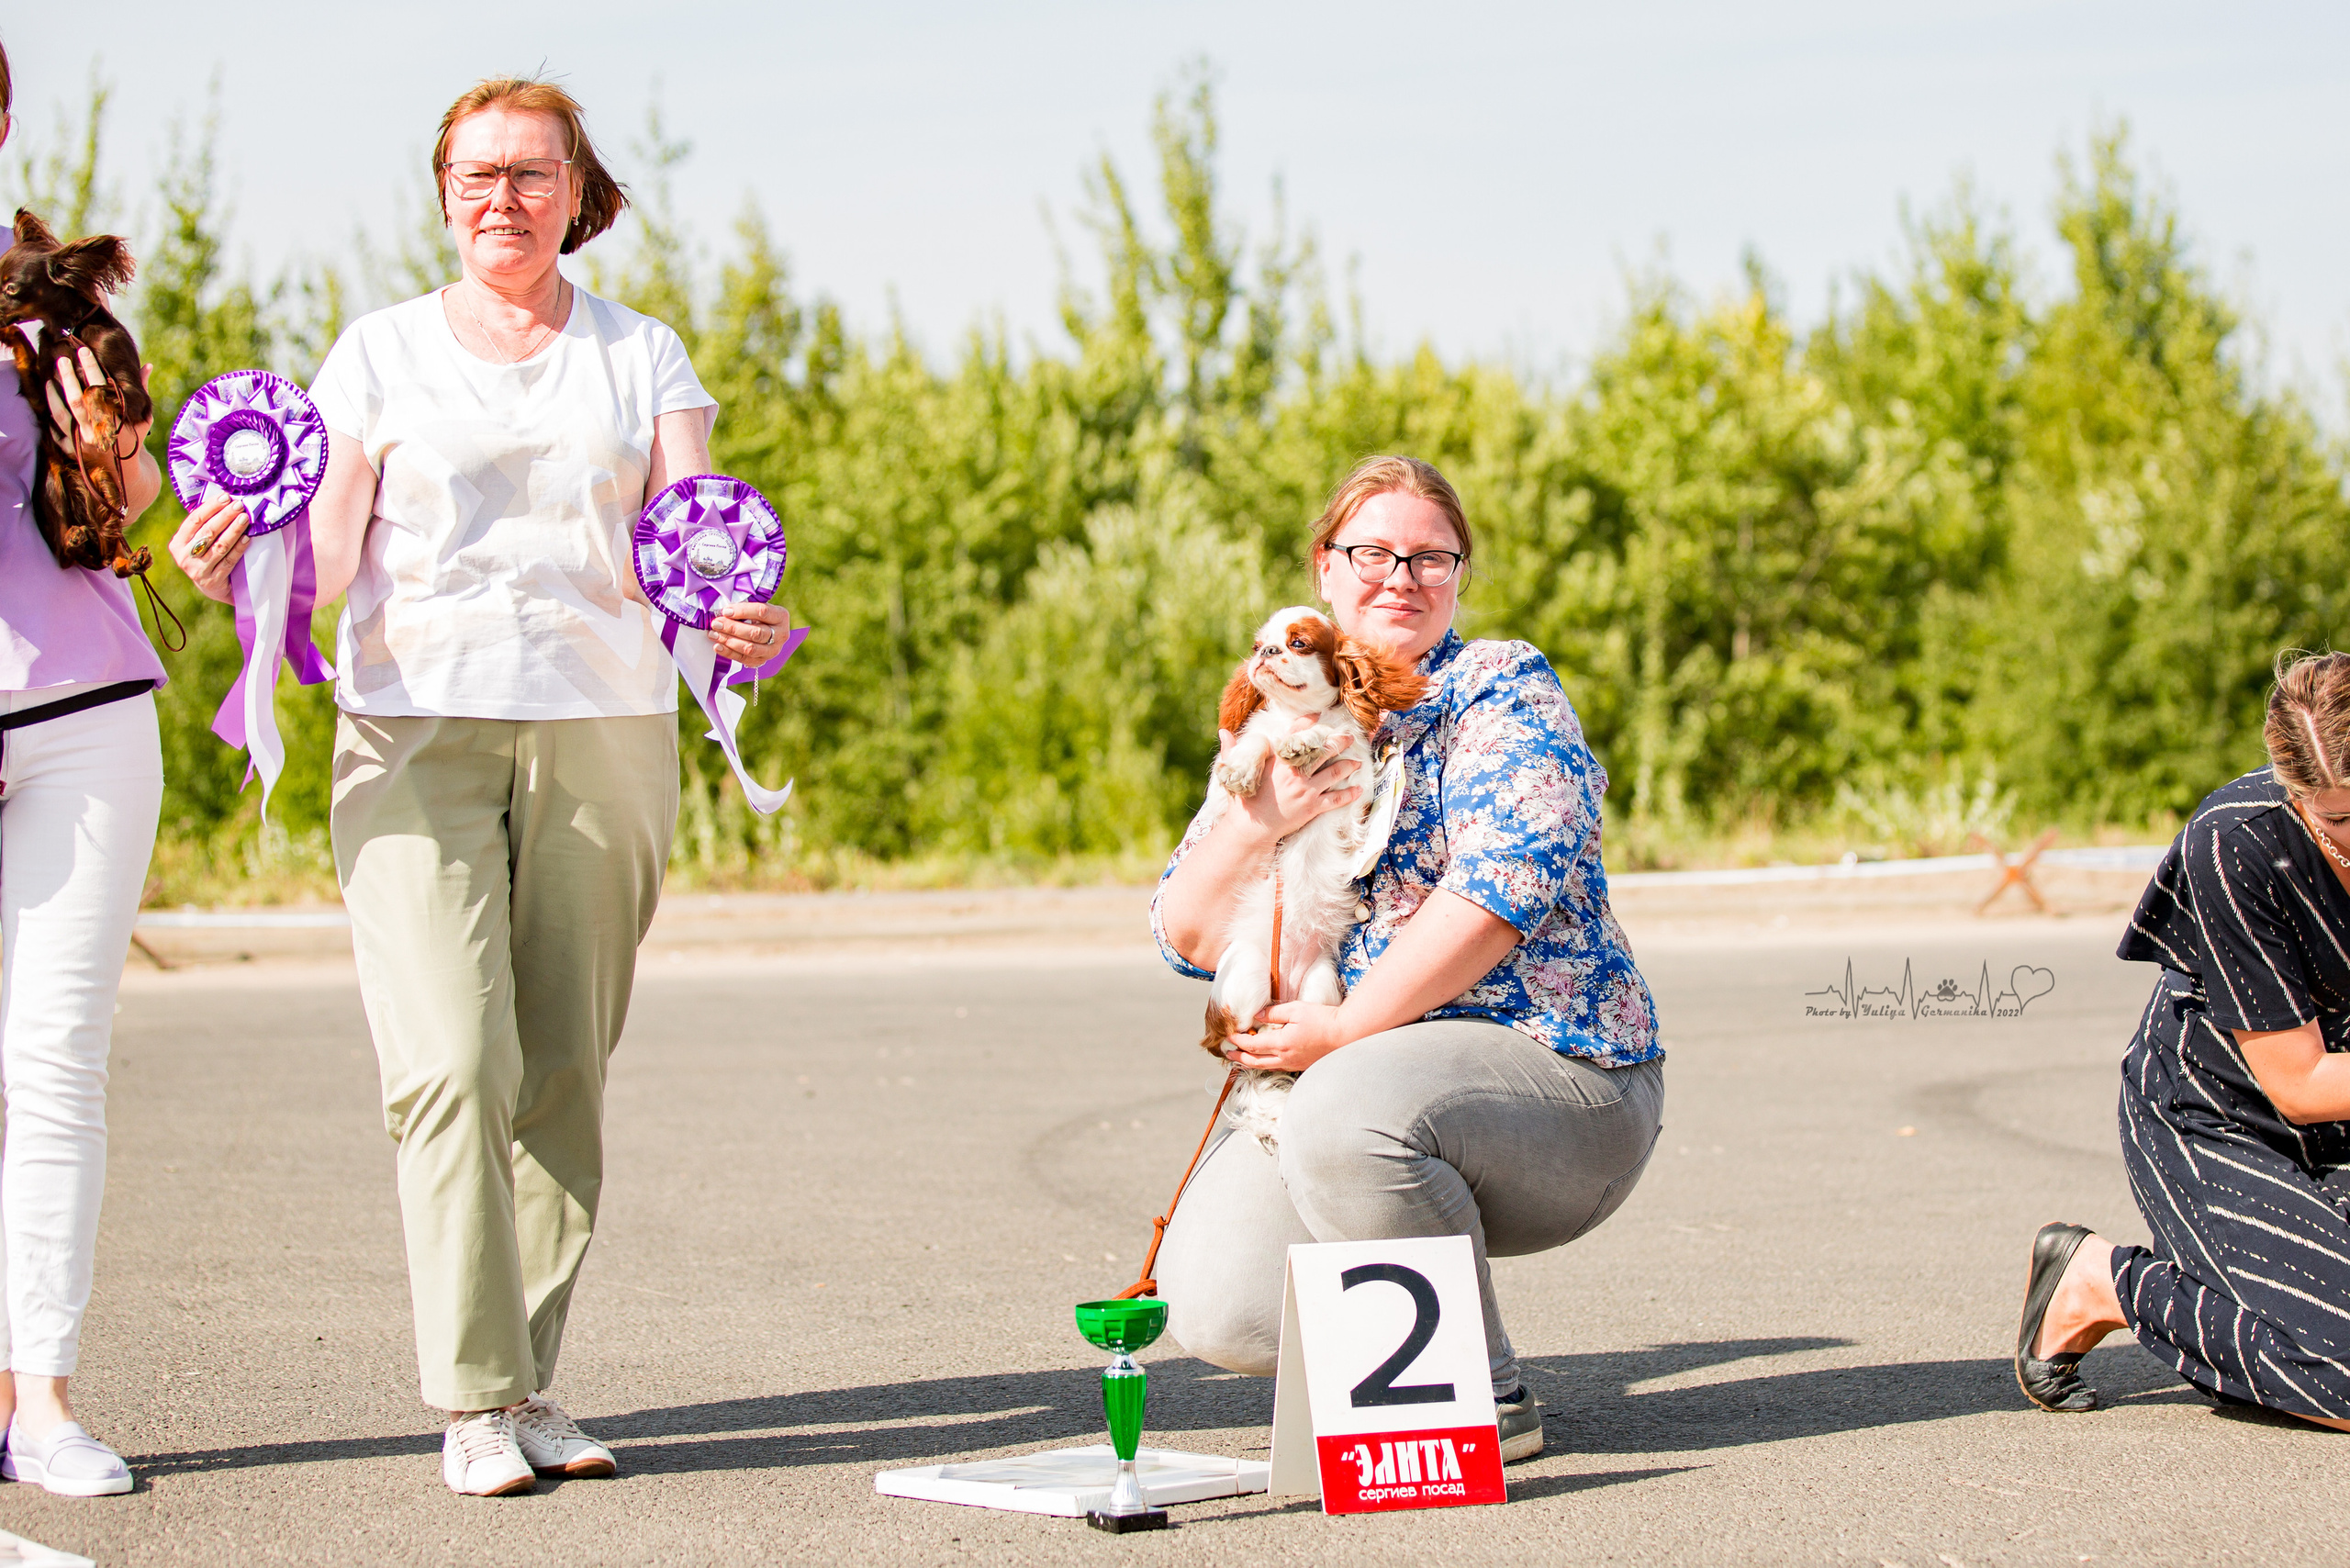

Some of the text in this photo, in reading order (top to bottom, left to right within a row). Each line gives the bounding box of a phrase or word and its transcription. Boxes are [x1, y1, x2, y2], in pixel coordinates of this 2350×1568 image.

[1340, 1262, 1456, 1408] 2
[1359, 1483, 1466, 1504] сергиев посад
